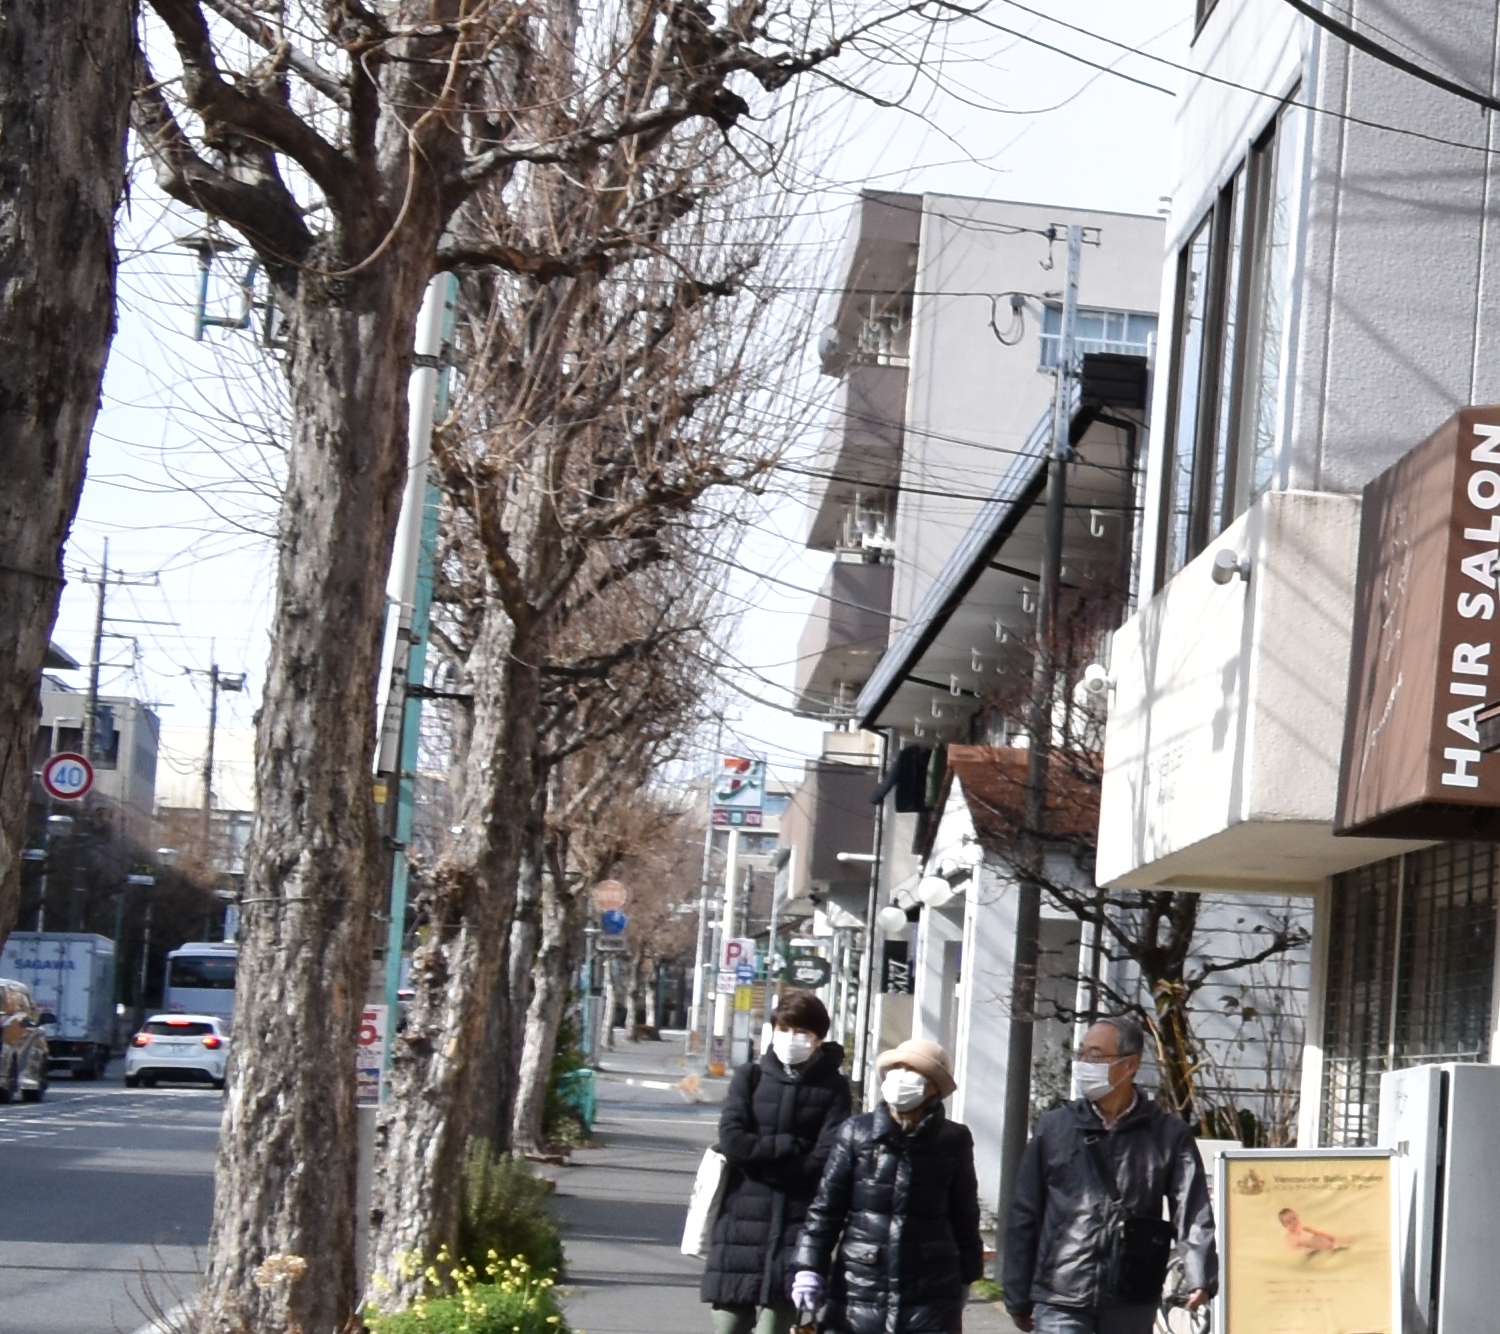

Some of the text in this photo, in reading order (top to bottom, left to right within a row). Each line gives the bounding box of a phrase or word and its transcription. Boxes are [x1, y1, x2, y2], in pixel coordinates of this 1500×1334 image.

[1441, 641, 1492, 788] HAIR
[52, 765, 84, 788] 40
[726, 942, 742, 967] P
